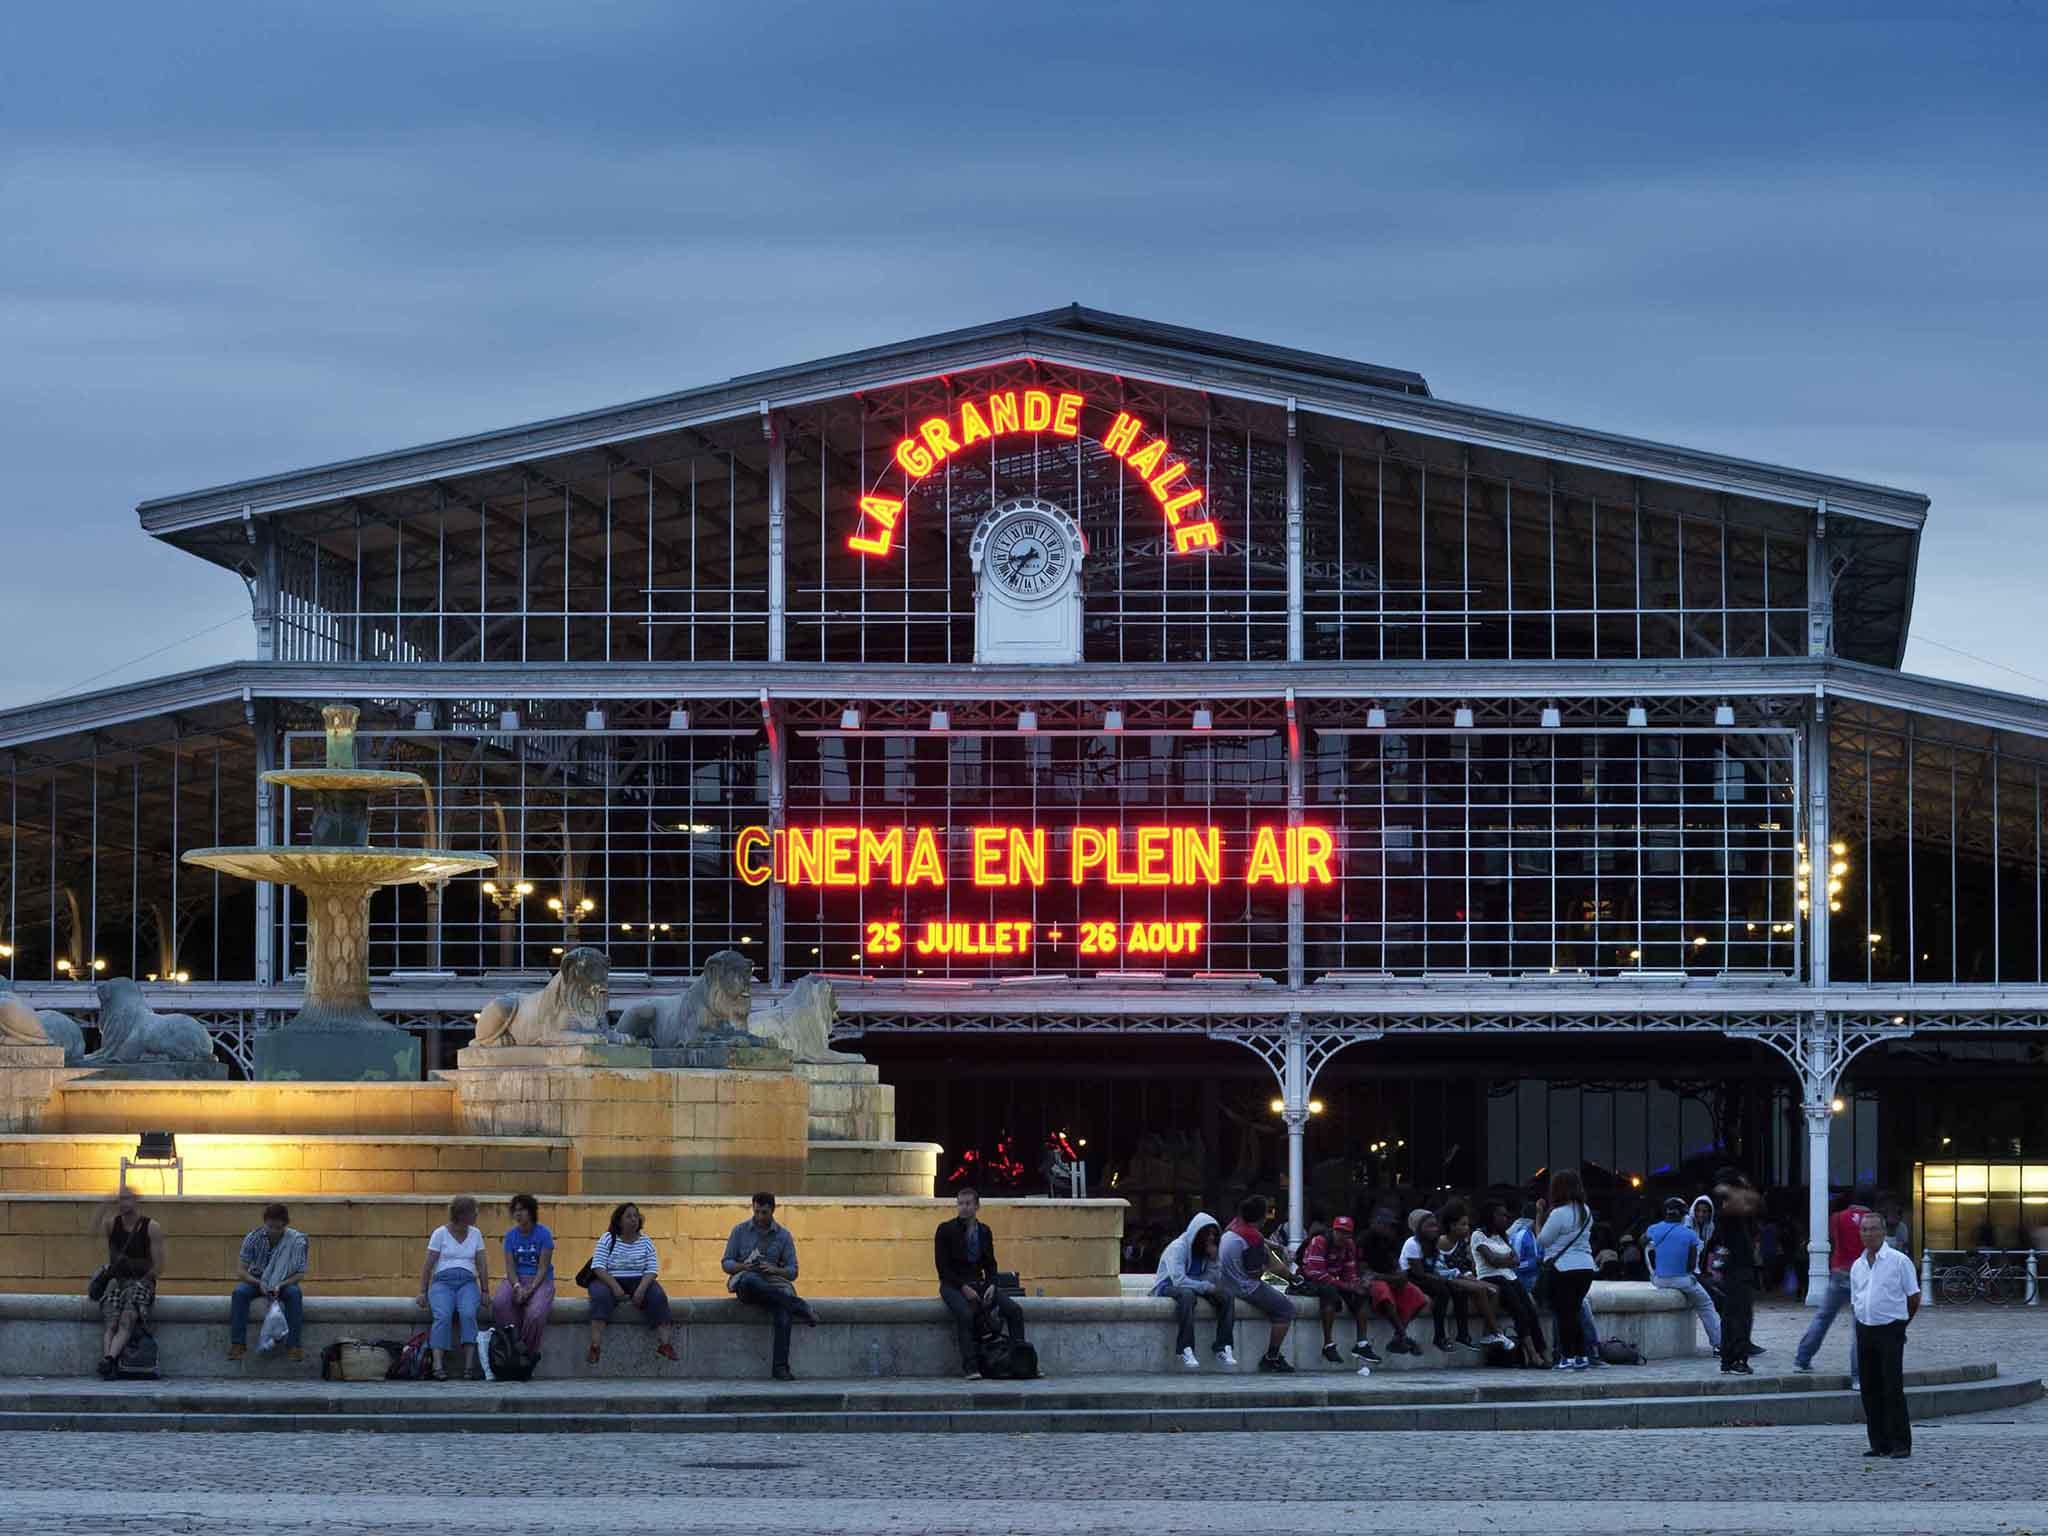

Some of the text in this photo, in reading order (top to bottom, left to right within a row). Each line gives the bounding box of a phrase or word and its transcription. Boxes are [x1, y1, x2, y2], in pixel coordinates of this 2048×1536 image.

[849, 390, 1218, 556] LA GRANDE HALLE
[736, 826, 1333, 886] CINEMA EN PLEIN AIR
[867, 922, 901, 953] 25
[917, 922, 1032, 953] JUILLET
[1080, 922, 1117, 953] 26
[1127, 922, 1202, 953] AOUT
